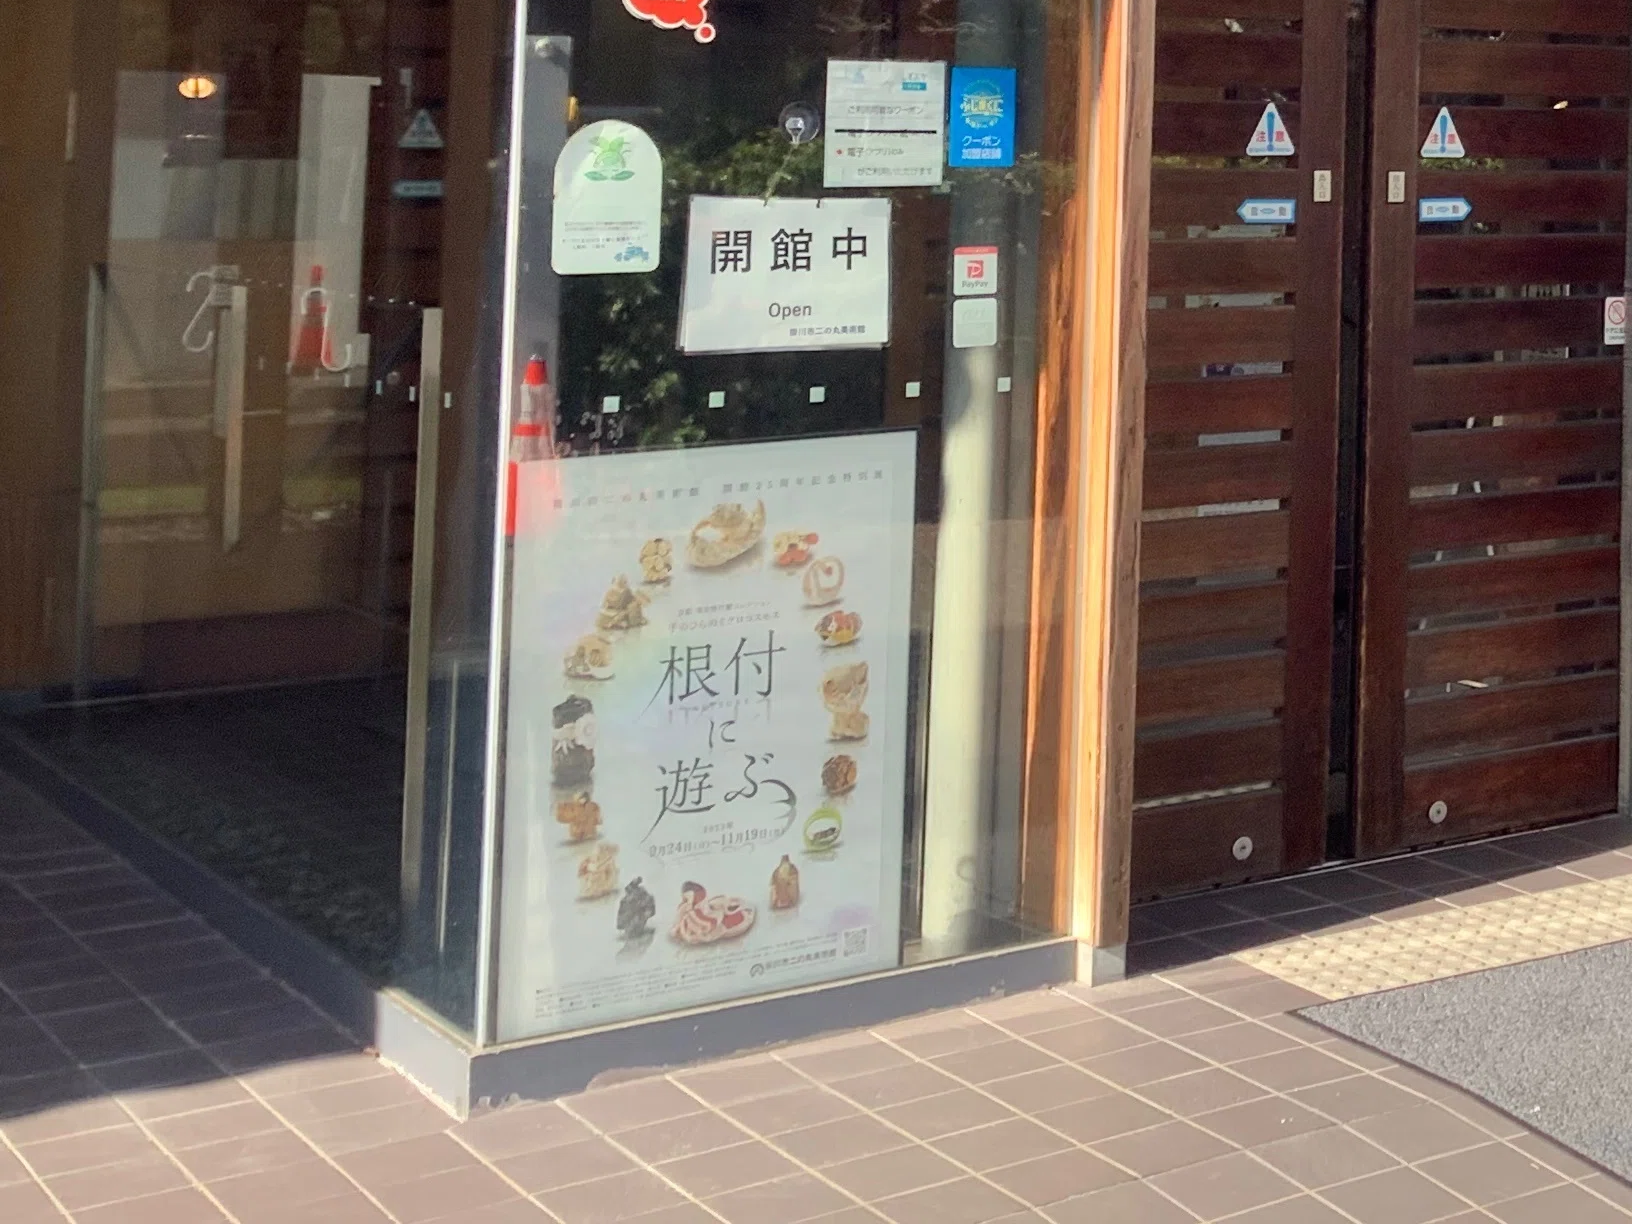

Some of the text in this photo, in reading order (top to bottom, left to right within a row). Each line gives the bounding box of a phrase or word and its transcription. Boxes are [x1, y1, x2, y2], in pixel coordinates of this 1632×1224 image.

[710, 227, 868, 274] 開館中
[961, 280, 989, 289] PayPay
[768, 302, 812, 320] Open
[641, 629, 787, 715] 根付
[709, 720, 736, 748] に
[640, 752, 797, 844] 遊ぶ
